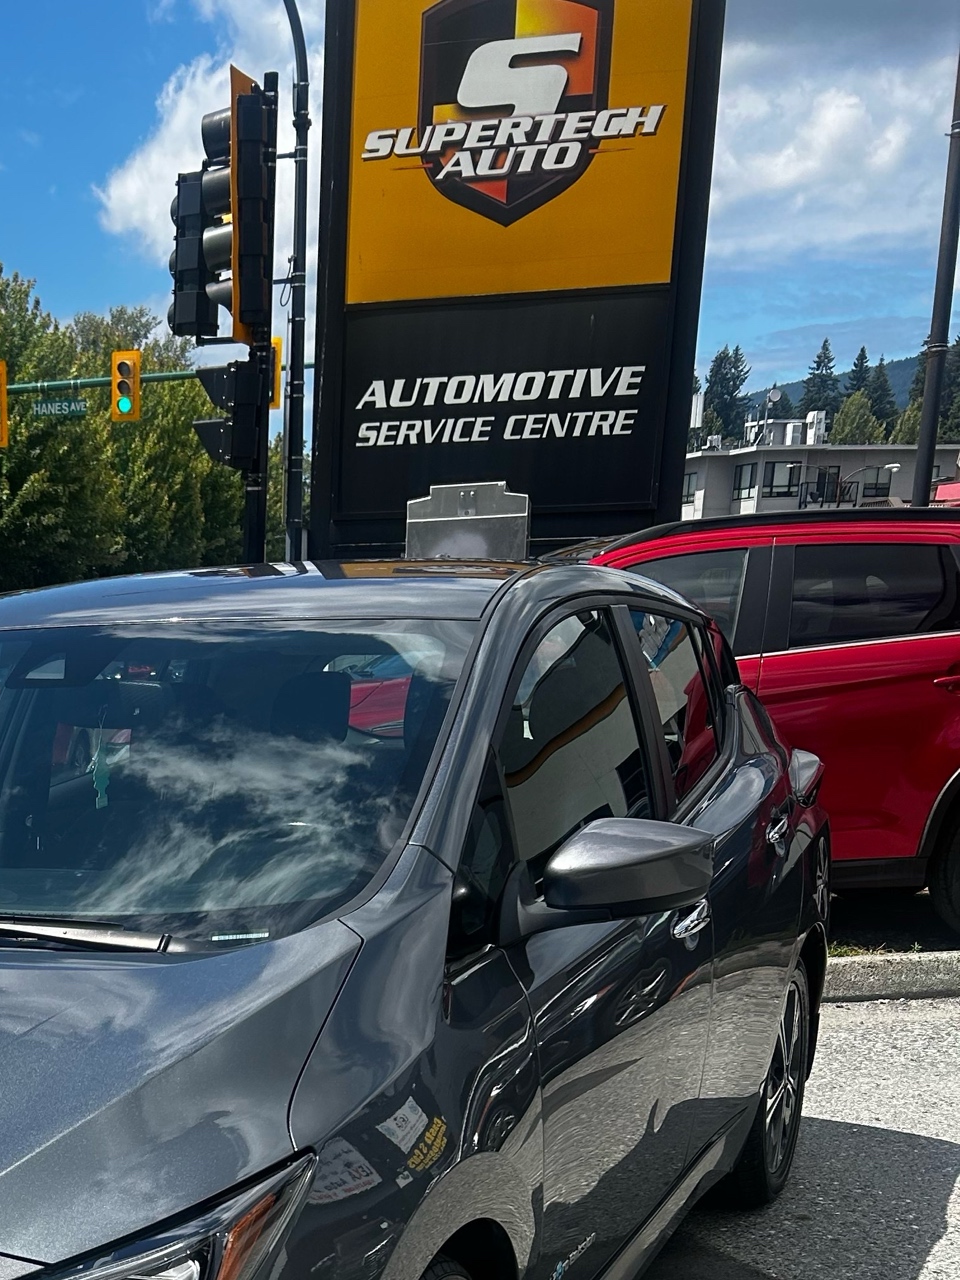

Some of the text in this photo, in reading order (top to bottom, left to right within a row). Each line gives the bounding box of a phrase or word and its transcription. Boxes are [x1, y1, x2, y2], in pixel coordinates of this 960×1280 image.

[361, 104, 667, 160] SUPERTECH
[435, 141, 583, 180] AUTO
[355, 365, 646, 410] AUTOMOTIVE
[33, 401, 87, 415] HANES AVE
[355, 409, 638, 447] SERVICE CENTRE
